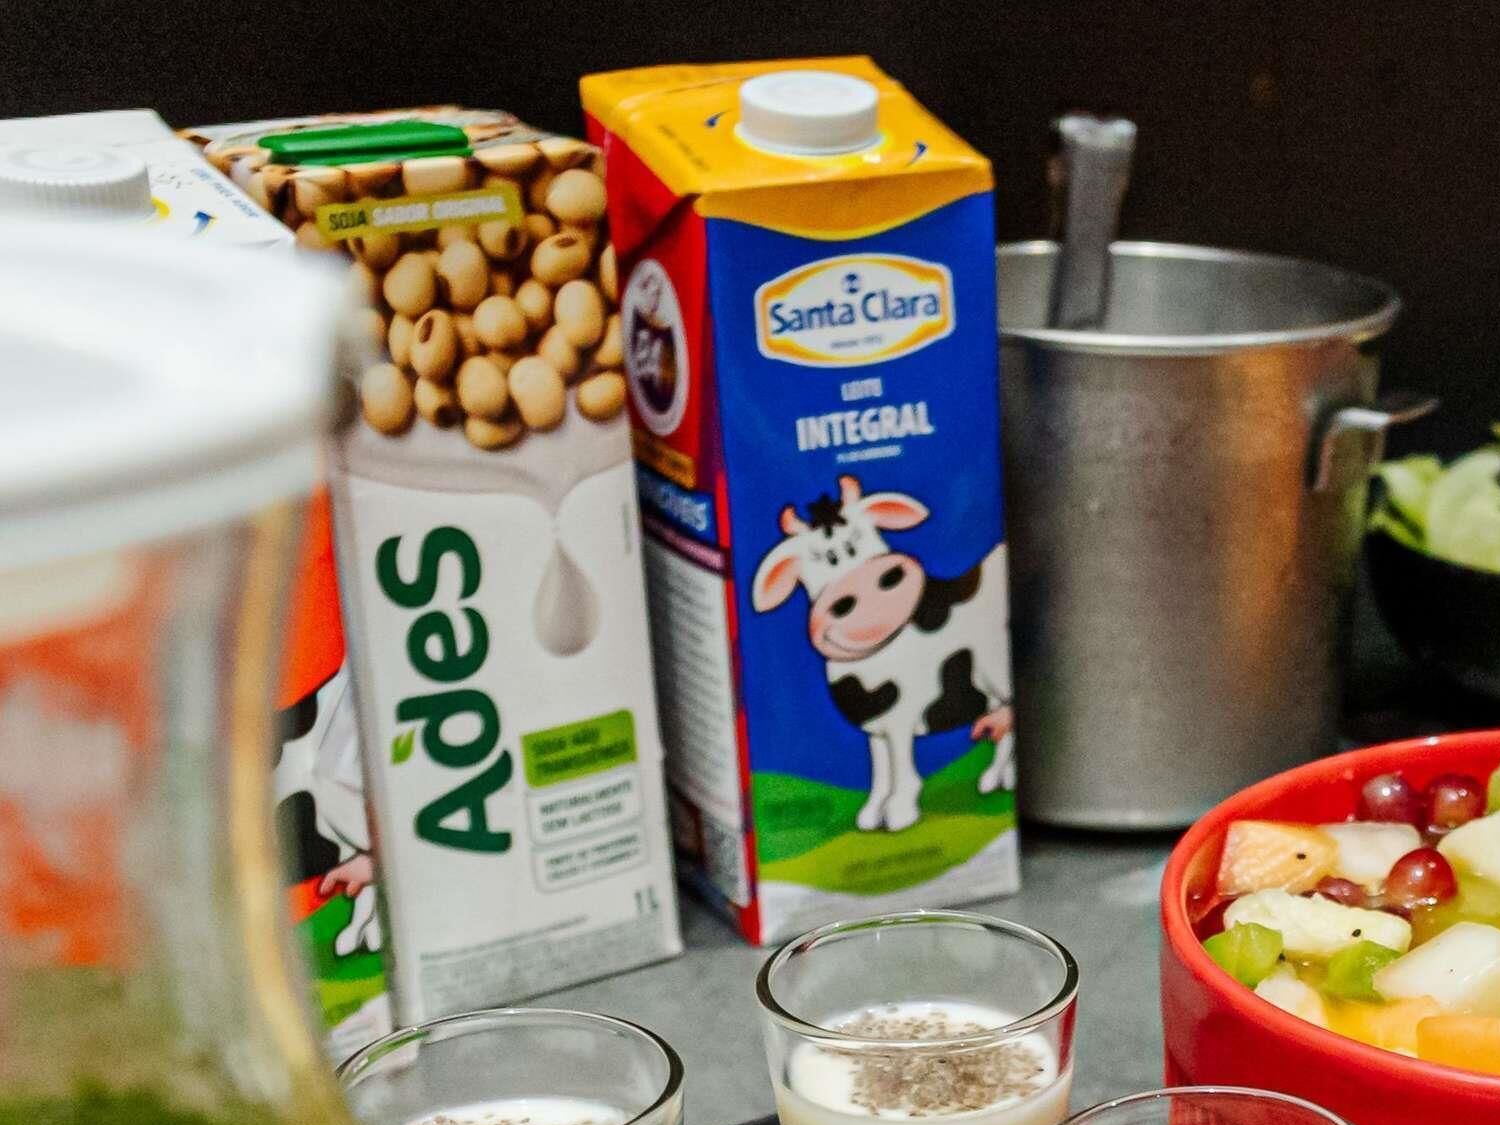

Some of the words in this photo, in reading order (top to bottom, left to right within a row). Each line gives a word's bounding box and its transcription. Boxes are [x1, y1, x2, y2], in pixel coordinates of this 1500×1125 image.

[328, 209, 368, 232] SOJA
[769, 301, 855, 335] Santa
[861, 289, 940, 322] Clara
[796, 401, 935, 451] INTEGRAL
